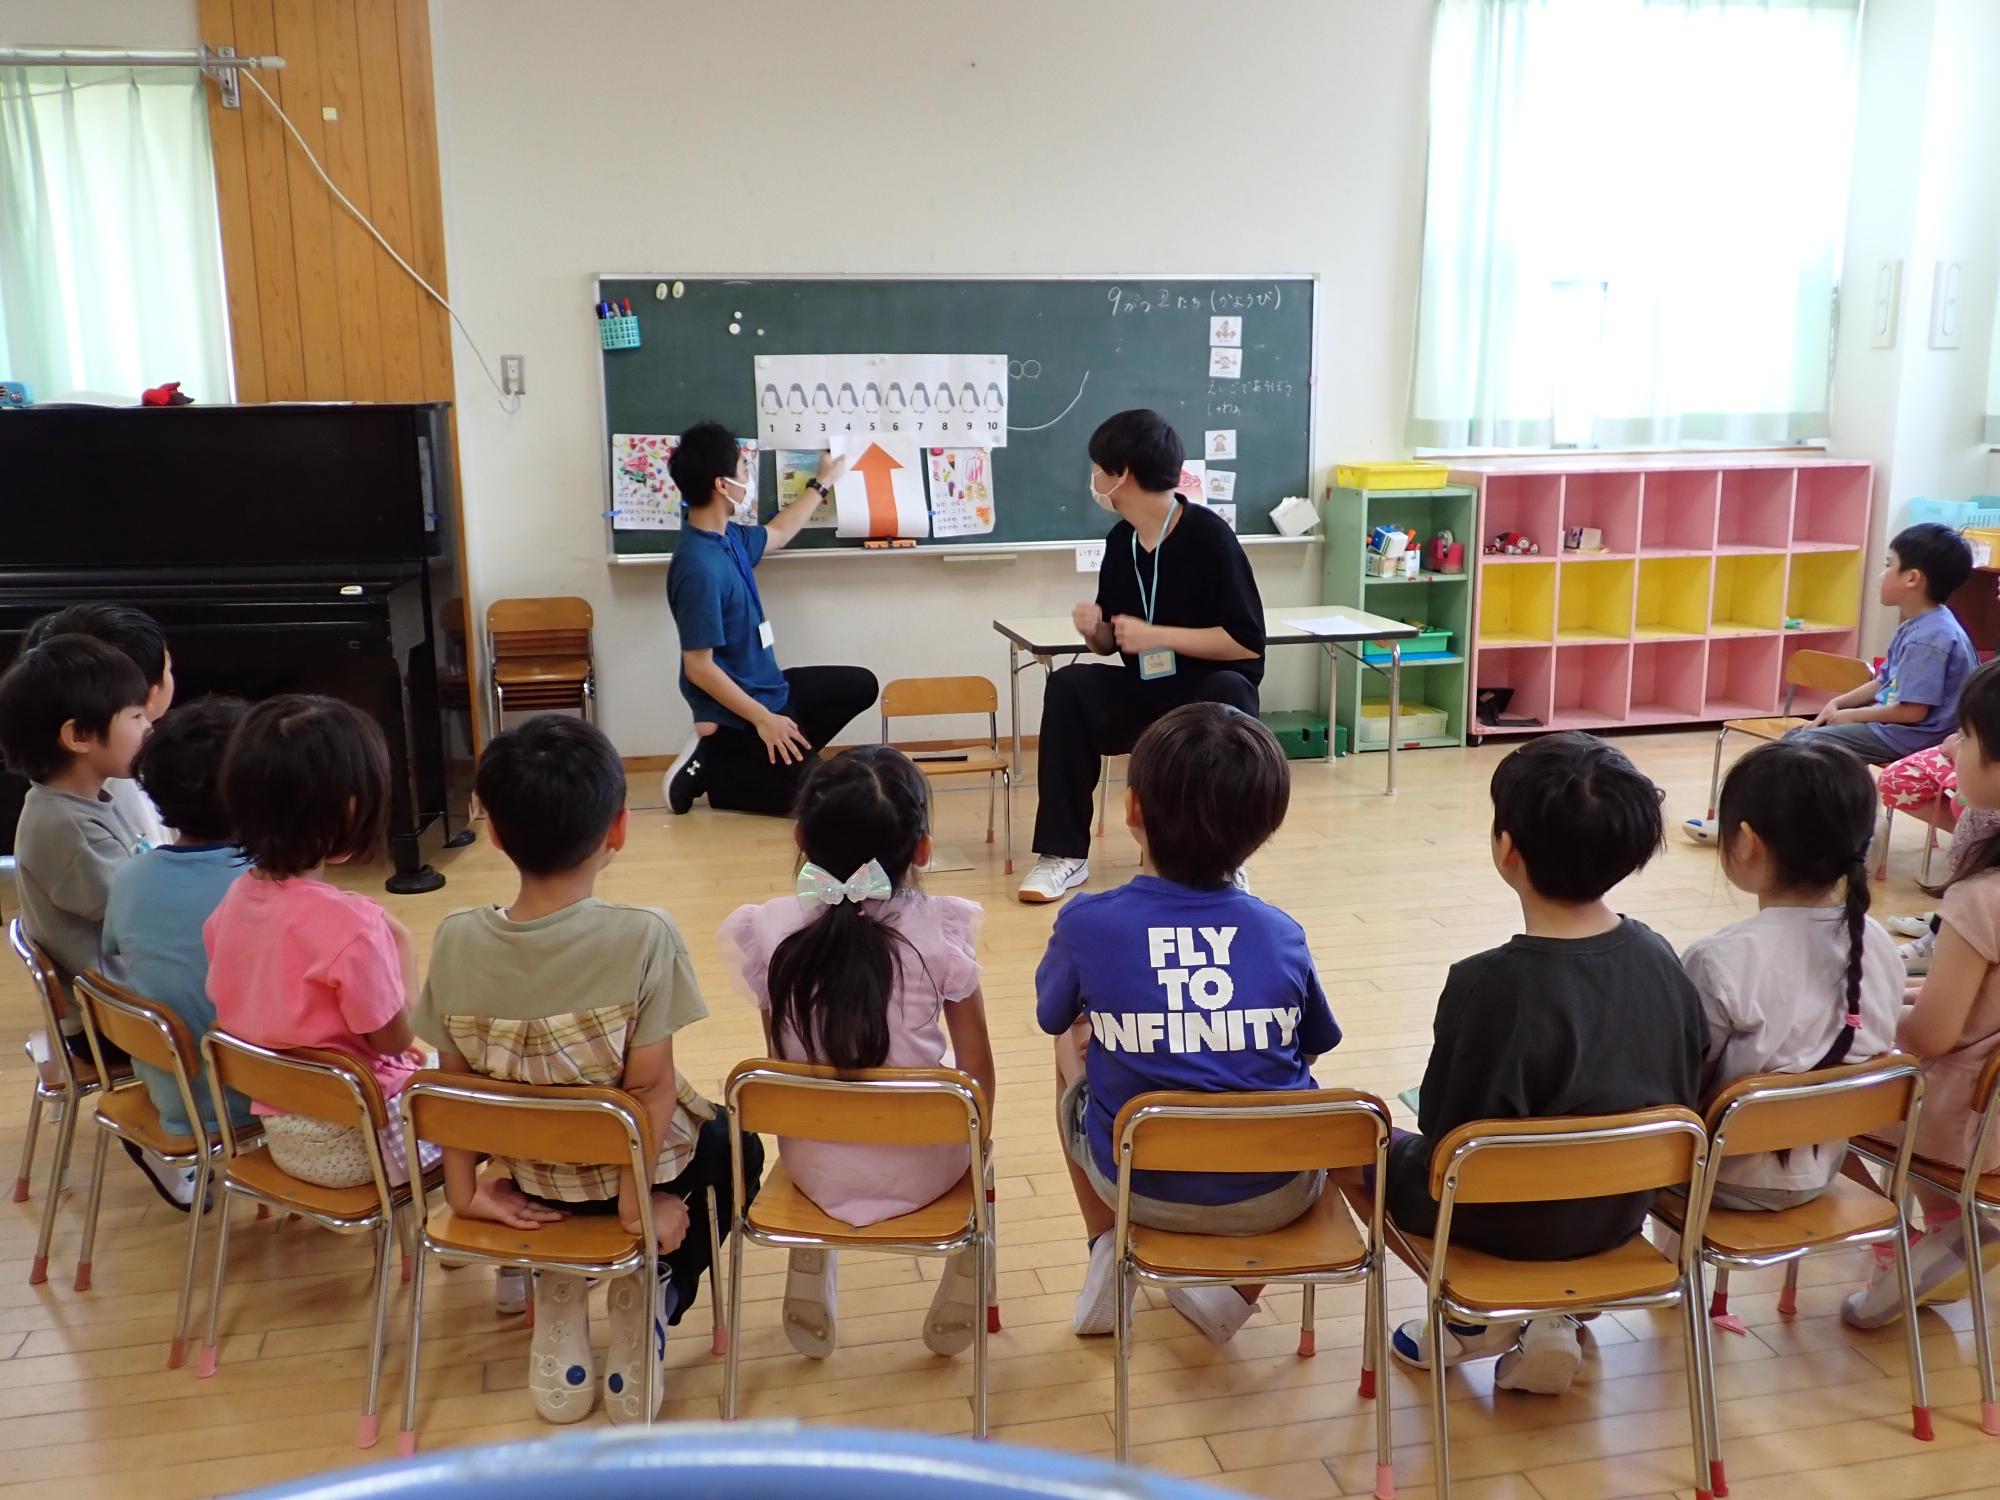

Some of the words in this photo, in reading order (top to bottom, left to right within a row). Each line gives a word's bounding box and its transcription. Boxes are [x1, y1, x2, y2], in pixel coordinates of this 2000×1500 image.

[769, 424, 774, 432] 1
[795, 423, 801, 432] 2
[820, 423, 826, 432] 3
[845, 422, 851, 431] 4
[869, 422, 876, 430] 5
[892, 422, 899, 430] 6
[917, 422, 923, 430] 7
[942, 422, 948, 430] 8
[966, 422, 973, 430] 9
[987, 422, 998, 430] 10
[1147, 926, 1238, 967] FLY
[1157, 967, 1234, 1011] TO
[1090, 1007, 1299, 1053] INFINITY
